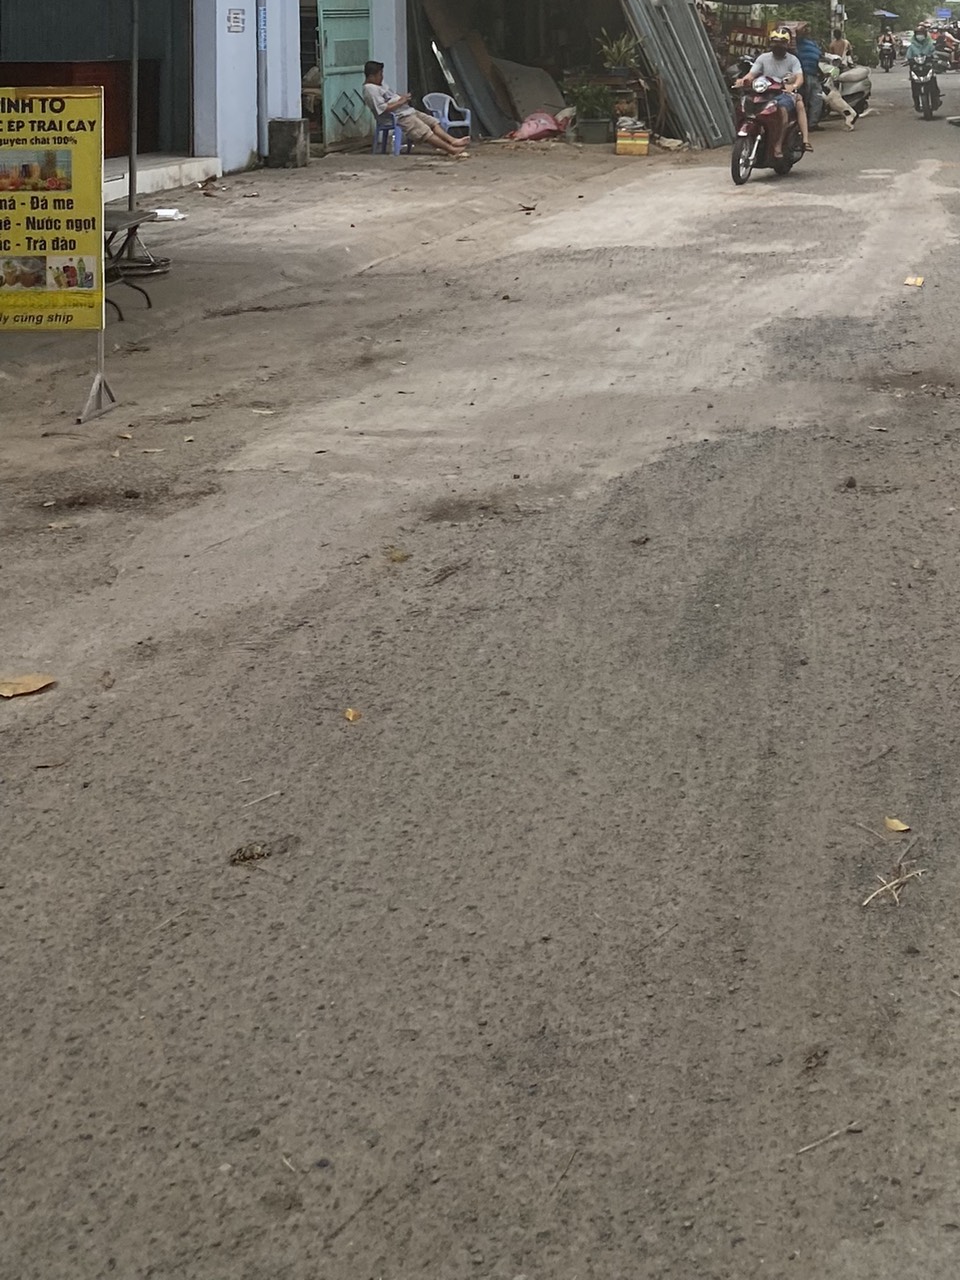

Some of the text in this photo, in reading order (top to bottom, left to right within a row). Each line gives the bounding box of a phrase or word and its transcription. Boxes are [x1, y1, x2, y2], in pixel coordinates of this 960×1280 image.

[30, 195, 48, 210] Đá
[53, 198, 74, 210] me
[25, 216, 61, 230] Nước
[65, 216, 96, 233] ngọt
[25, 236, 47, 251] Trà
[51, 236, 77, 251] đào
[47, 312, 73, 324] ship
